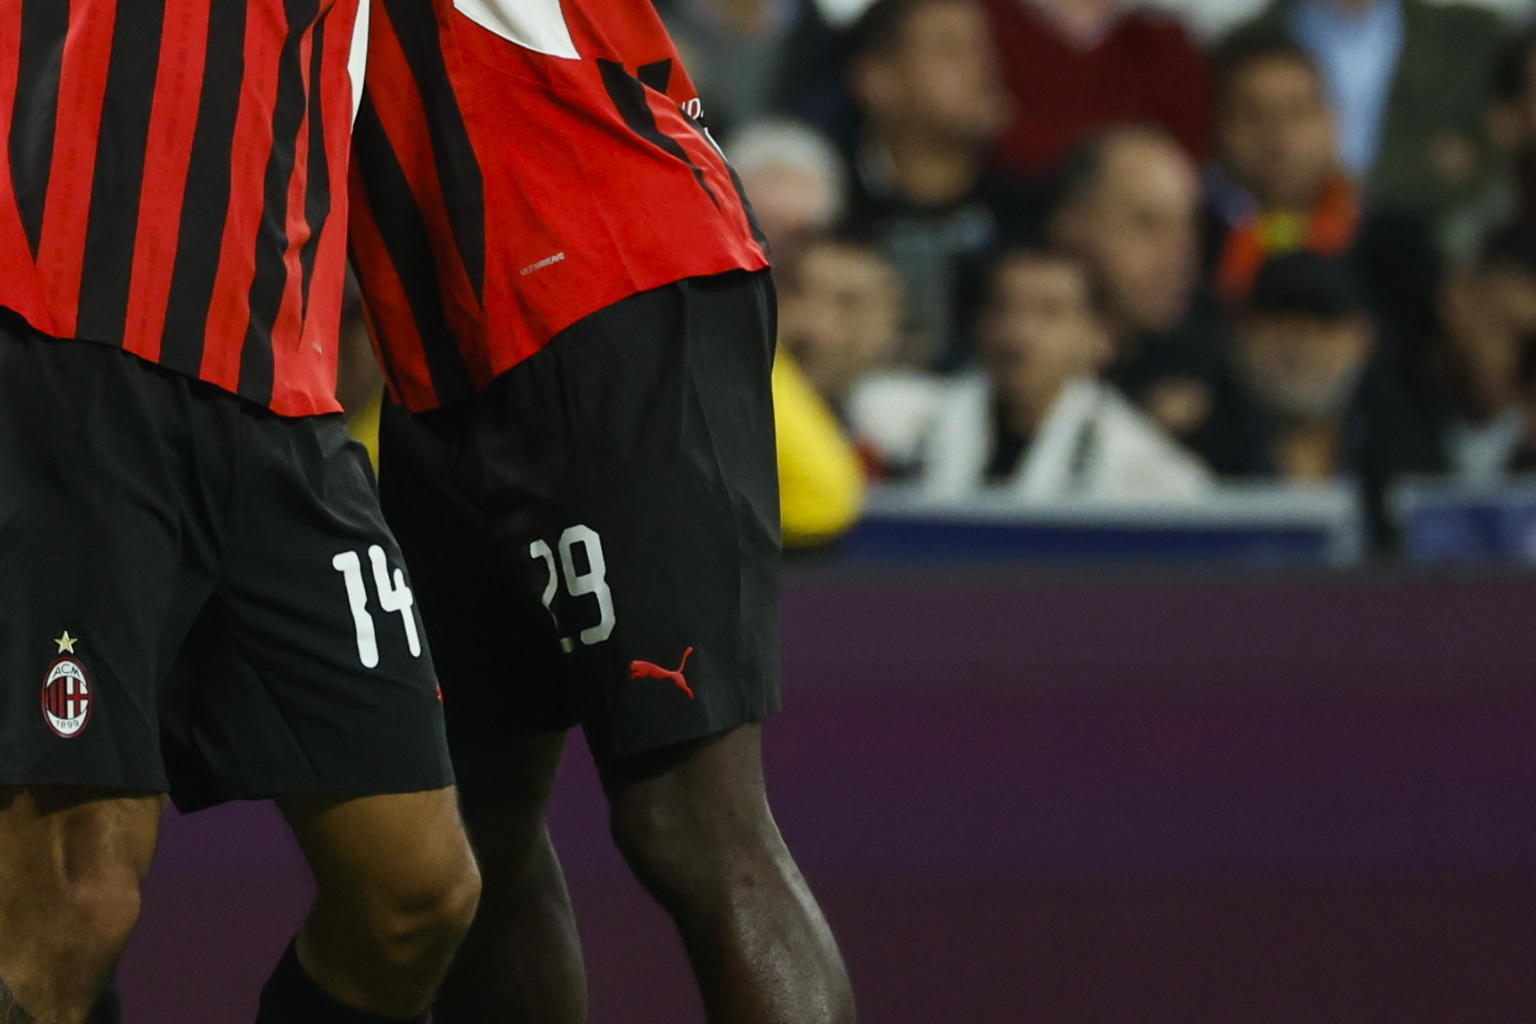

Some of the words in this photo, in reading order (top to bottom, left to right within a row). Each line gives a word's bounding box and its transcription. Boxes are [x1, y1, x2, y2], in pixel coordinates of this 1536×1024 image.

[332, 544, 421, 668] 14
[53, 663, 81, 678] ACM
[56, 719, 79, 729] 1899
